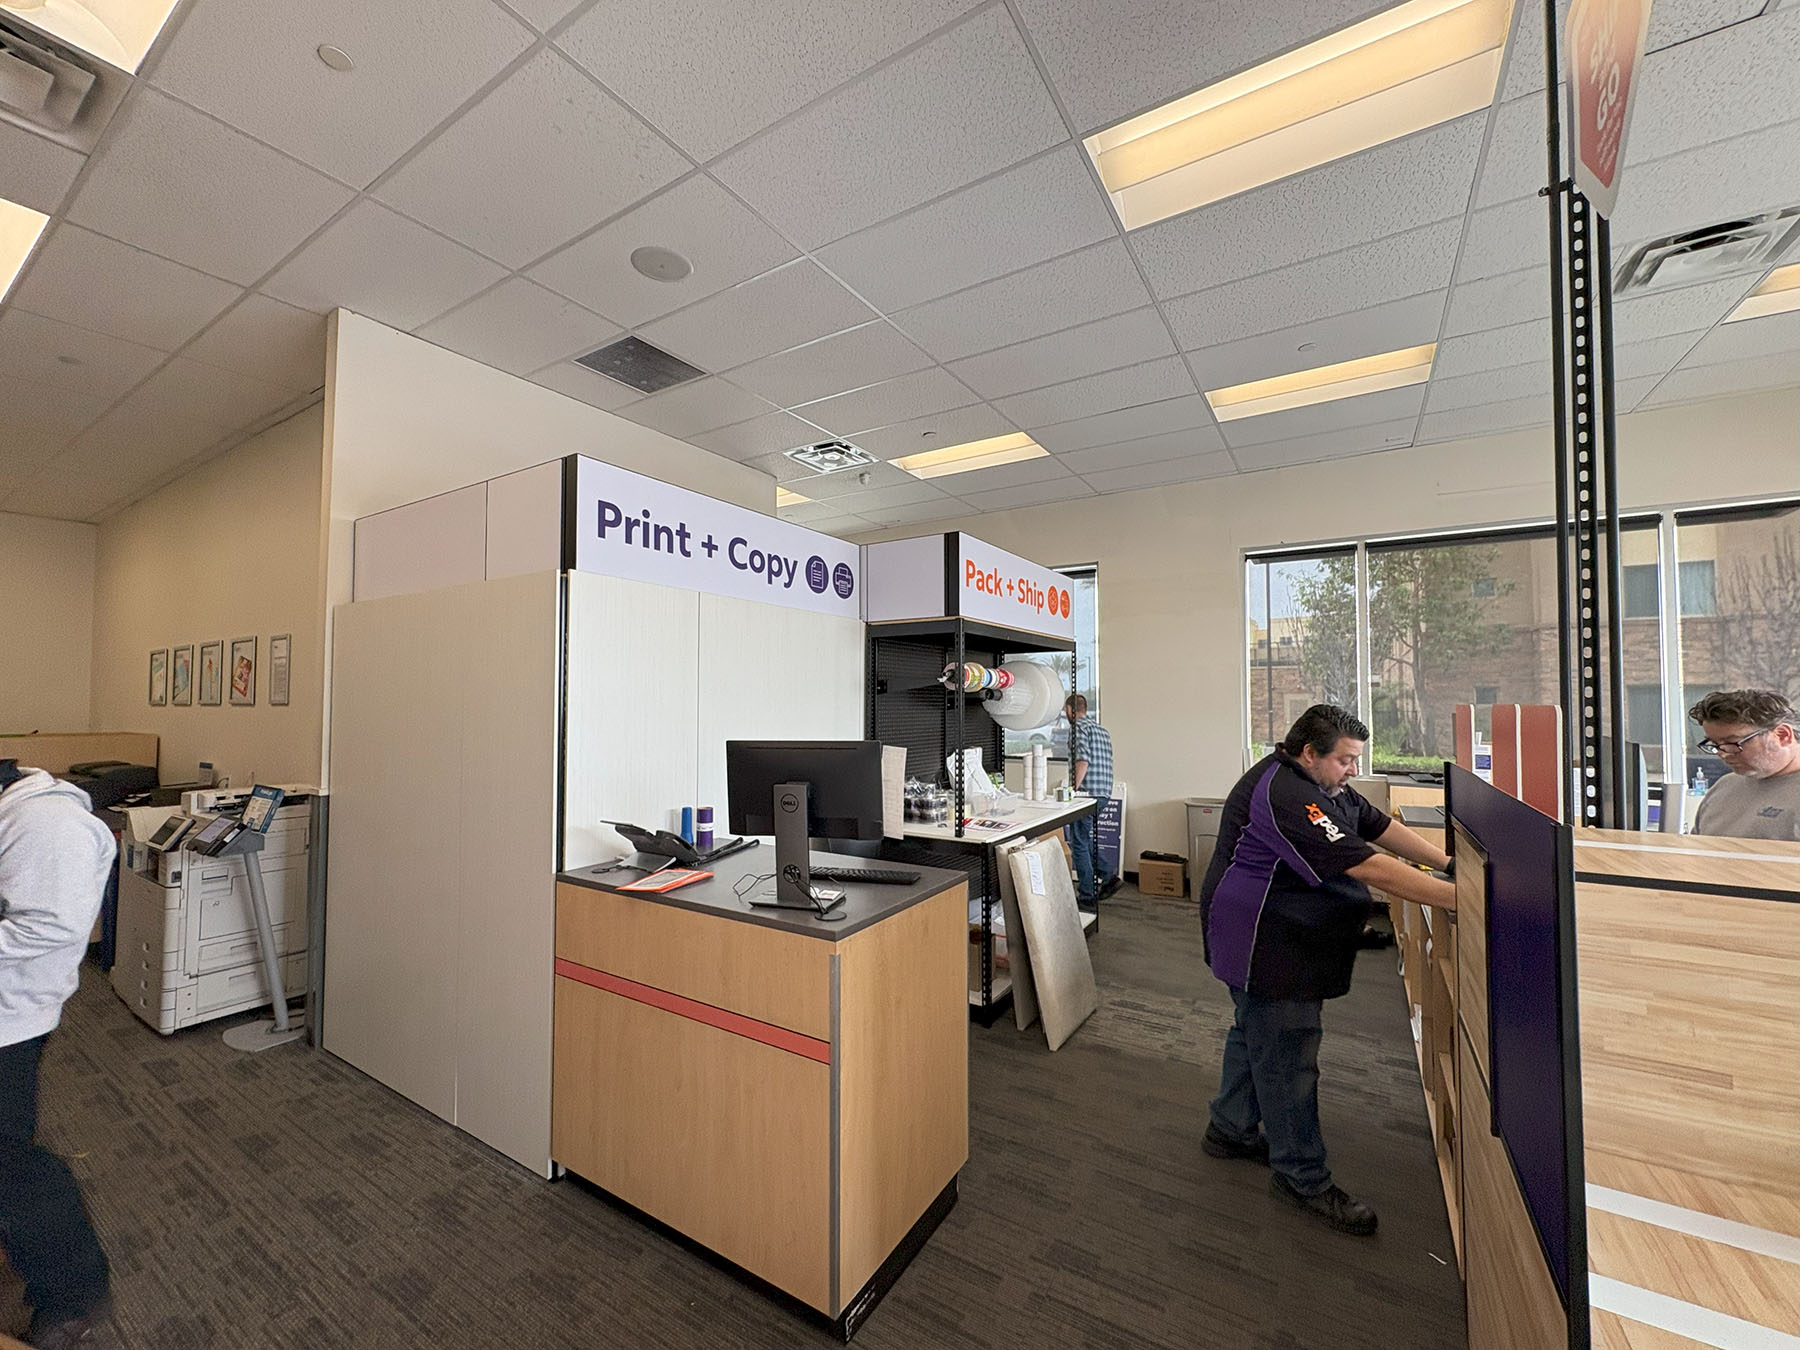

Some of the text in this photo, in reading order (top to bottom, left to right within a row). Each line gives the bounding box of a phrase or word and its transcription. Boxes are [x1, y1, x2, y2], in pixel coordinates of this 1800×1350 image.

[1597, 61, 1620, 131] GO
[597, 499, 798, 589] Print + Copy
[965, 559, 1044, 615] Pack + Ship
[1304, 803, 1346, 842] FedEx
